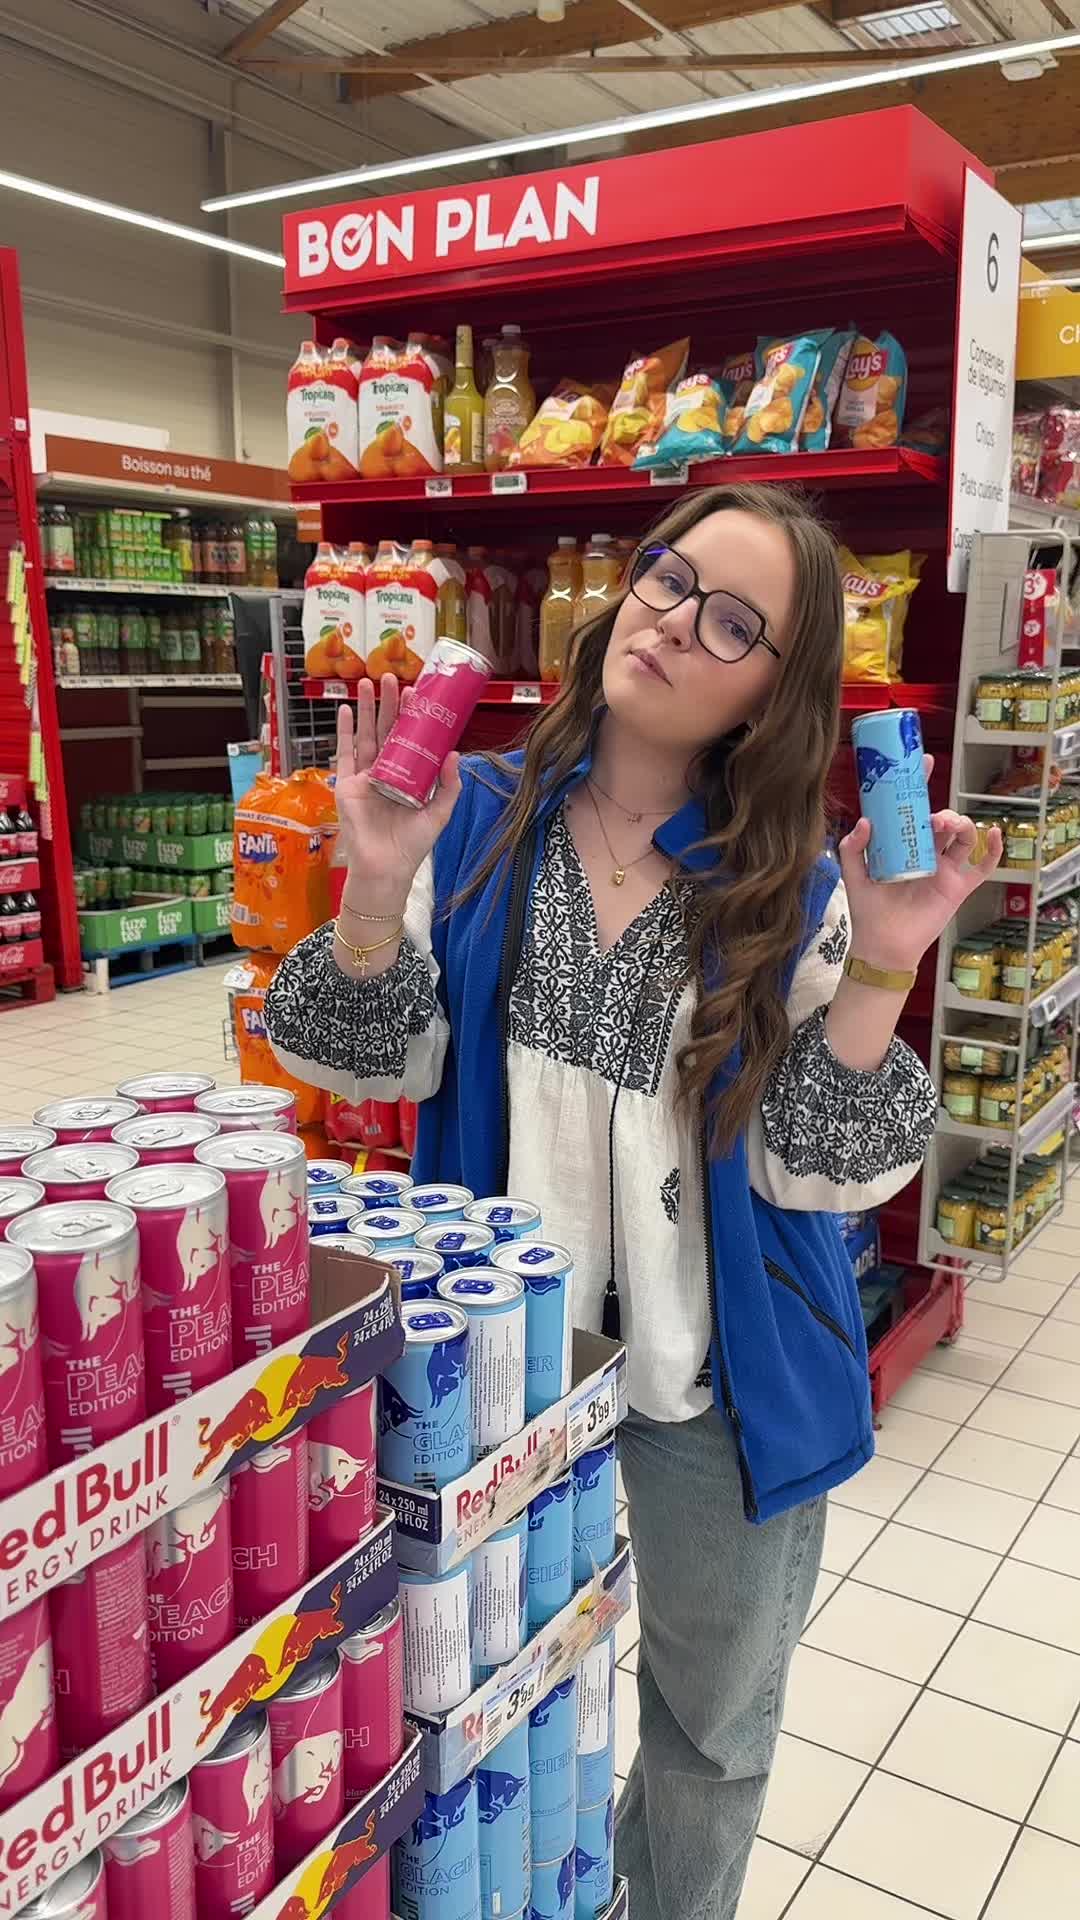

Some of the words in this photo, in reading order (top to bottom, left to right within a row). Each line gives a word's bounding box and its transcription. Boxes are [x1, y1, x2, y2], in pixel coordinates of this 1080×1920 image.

[298, 205, 414, 278] BON
[435, 176, 600, 257] PLAN
[986, 232, 1000, 292] 6
[121, 454, 172, 476] Boisson
[174, 466, 189, 478] au
[190, 466, 212, 482] thé
[316, 587, 351, 605] Tropicana
[375, 589, 414, 606] Tropicana
[157, 839, 184, 856] fuze
[238, 831, 278, 855] FANTA
[120, 916, 148, 932] fuze
[158, 910, 183, 924] fuze
[158, 920, 178, 936] tea
[121, 927, 143, 944] tea
[251, 1261, 281, 1275] THE
[169, 1304, 202, 1320] THE
[252, 1288, 306, 1316] EDITION
[170, 1333, 229, 1363] EDITION
[66, 1356, 102, 1371] THE
[69, 1383, 137, 1416] EDITION
[413, 1420, 440, 1430] THE
[414, 1446, 464, 1465] EDITION
[76, 1421, 169, 1527] Bull
[379, 1490, 390, 1505] 24
[398, 1496, 416, 1512] 250
[417, 1504, 429, 1517] ml
[456, 1463, 498, 1528] Red
[90, 1485, 169, 1551] DRINK
[83, 1700, 171, 1816] Bull
[98, 1758, 173, 1836] DRINK
[236, 1831, 261, 1852] THE
